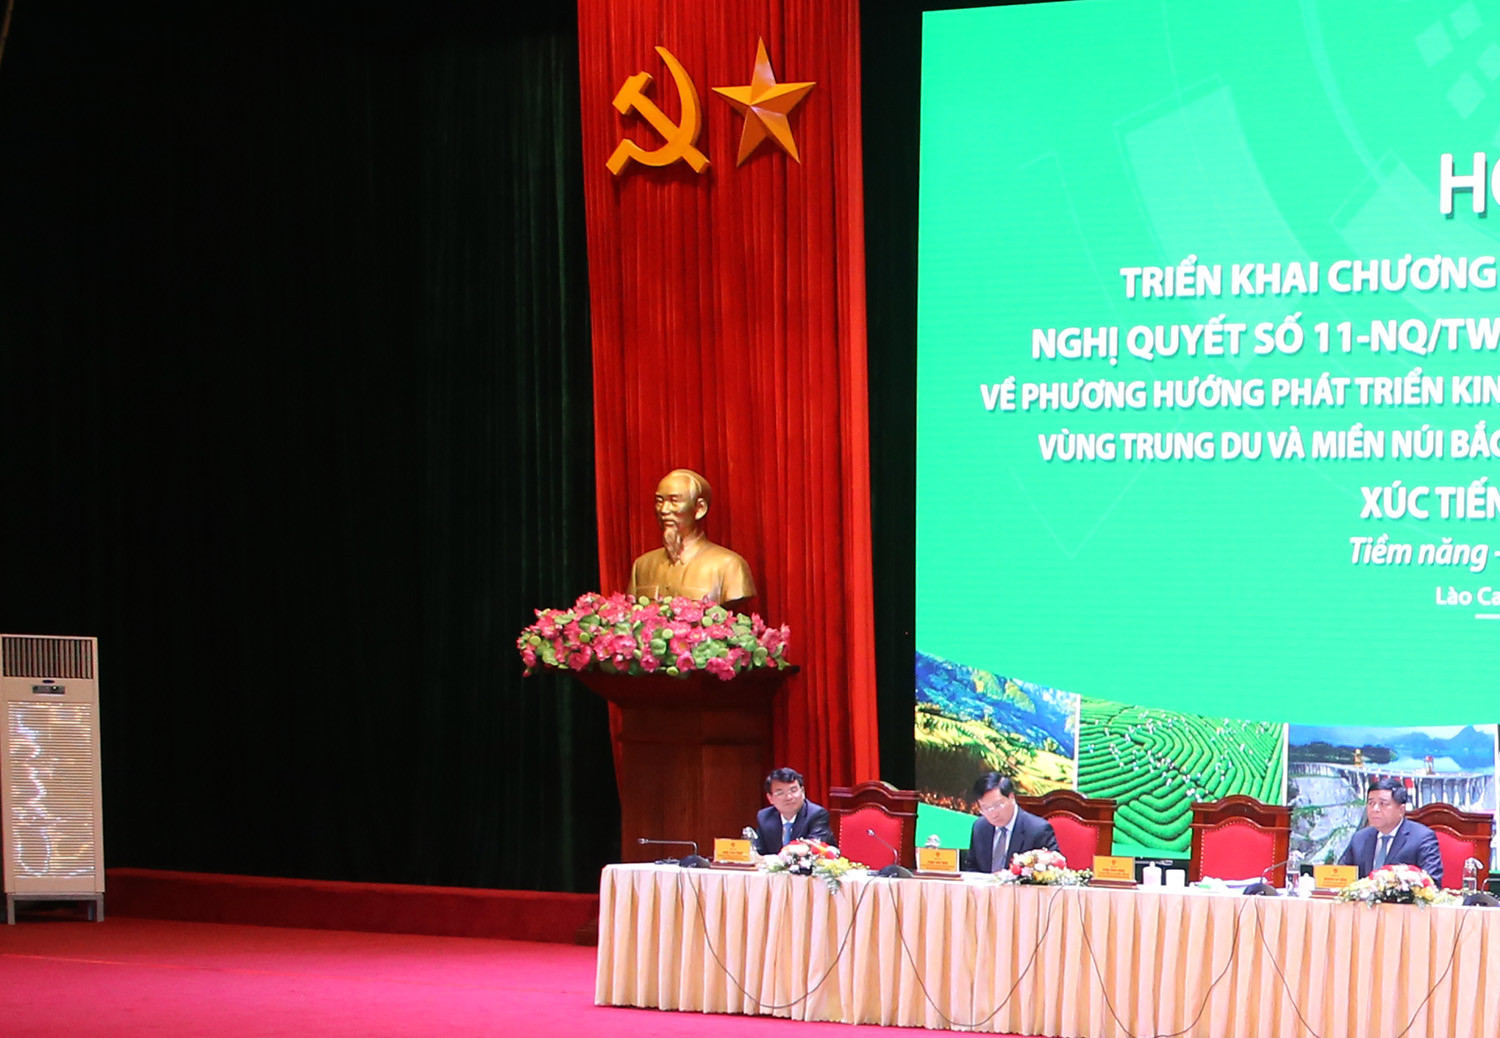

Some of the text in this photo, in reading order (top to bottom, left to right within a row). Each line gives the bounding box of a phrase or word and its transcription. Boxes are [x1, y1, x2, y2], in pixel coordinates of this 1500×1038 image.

[1119, 253, 1222, 299] TRIỂN
[1230, 261, 1319, 295] KHAI
[1327, 253, 1497, 293] CHƯƠNG
[1031, 326, 1119, 366] NGHỊ
[1126, 313, 1247, 361] QUYẾT
[1253, 311, 1304, 354] SỐ
[979, 375, 1016, 410] VỀ
[1021, 378, 1147, 410] PHƯƠNG
[1153, 373, 1265, 408] HƯỚNG
[1271, 371, 1351, 406] PHÁT
[1353, 366, 1444, 405] TRIỂN
[1037, 428, 1116, 461] VÙNG
[1119, 431, 1215, 460] TRUNG
[1220, 431, 1262, 459] DU
[1266, 425, 1306, 459] VÀ
[1311, 422, 1385, 459] MIỀN
[1391, 423, 1444, 458] NÚI
[1359, 480, 1430, 519] XÚC
[1349, 532, 1413, 564] Tiềm
[1417, 536, 1489, 572] năng
[1435, 586, 1473, 606] Lào
